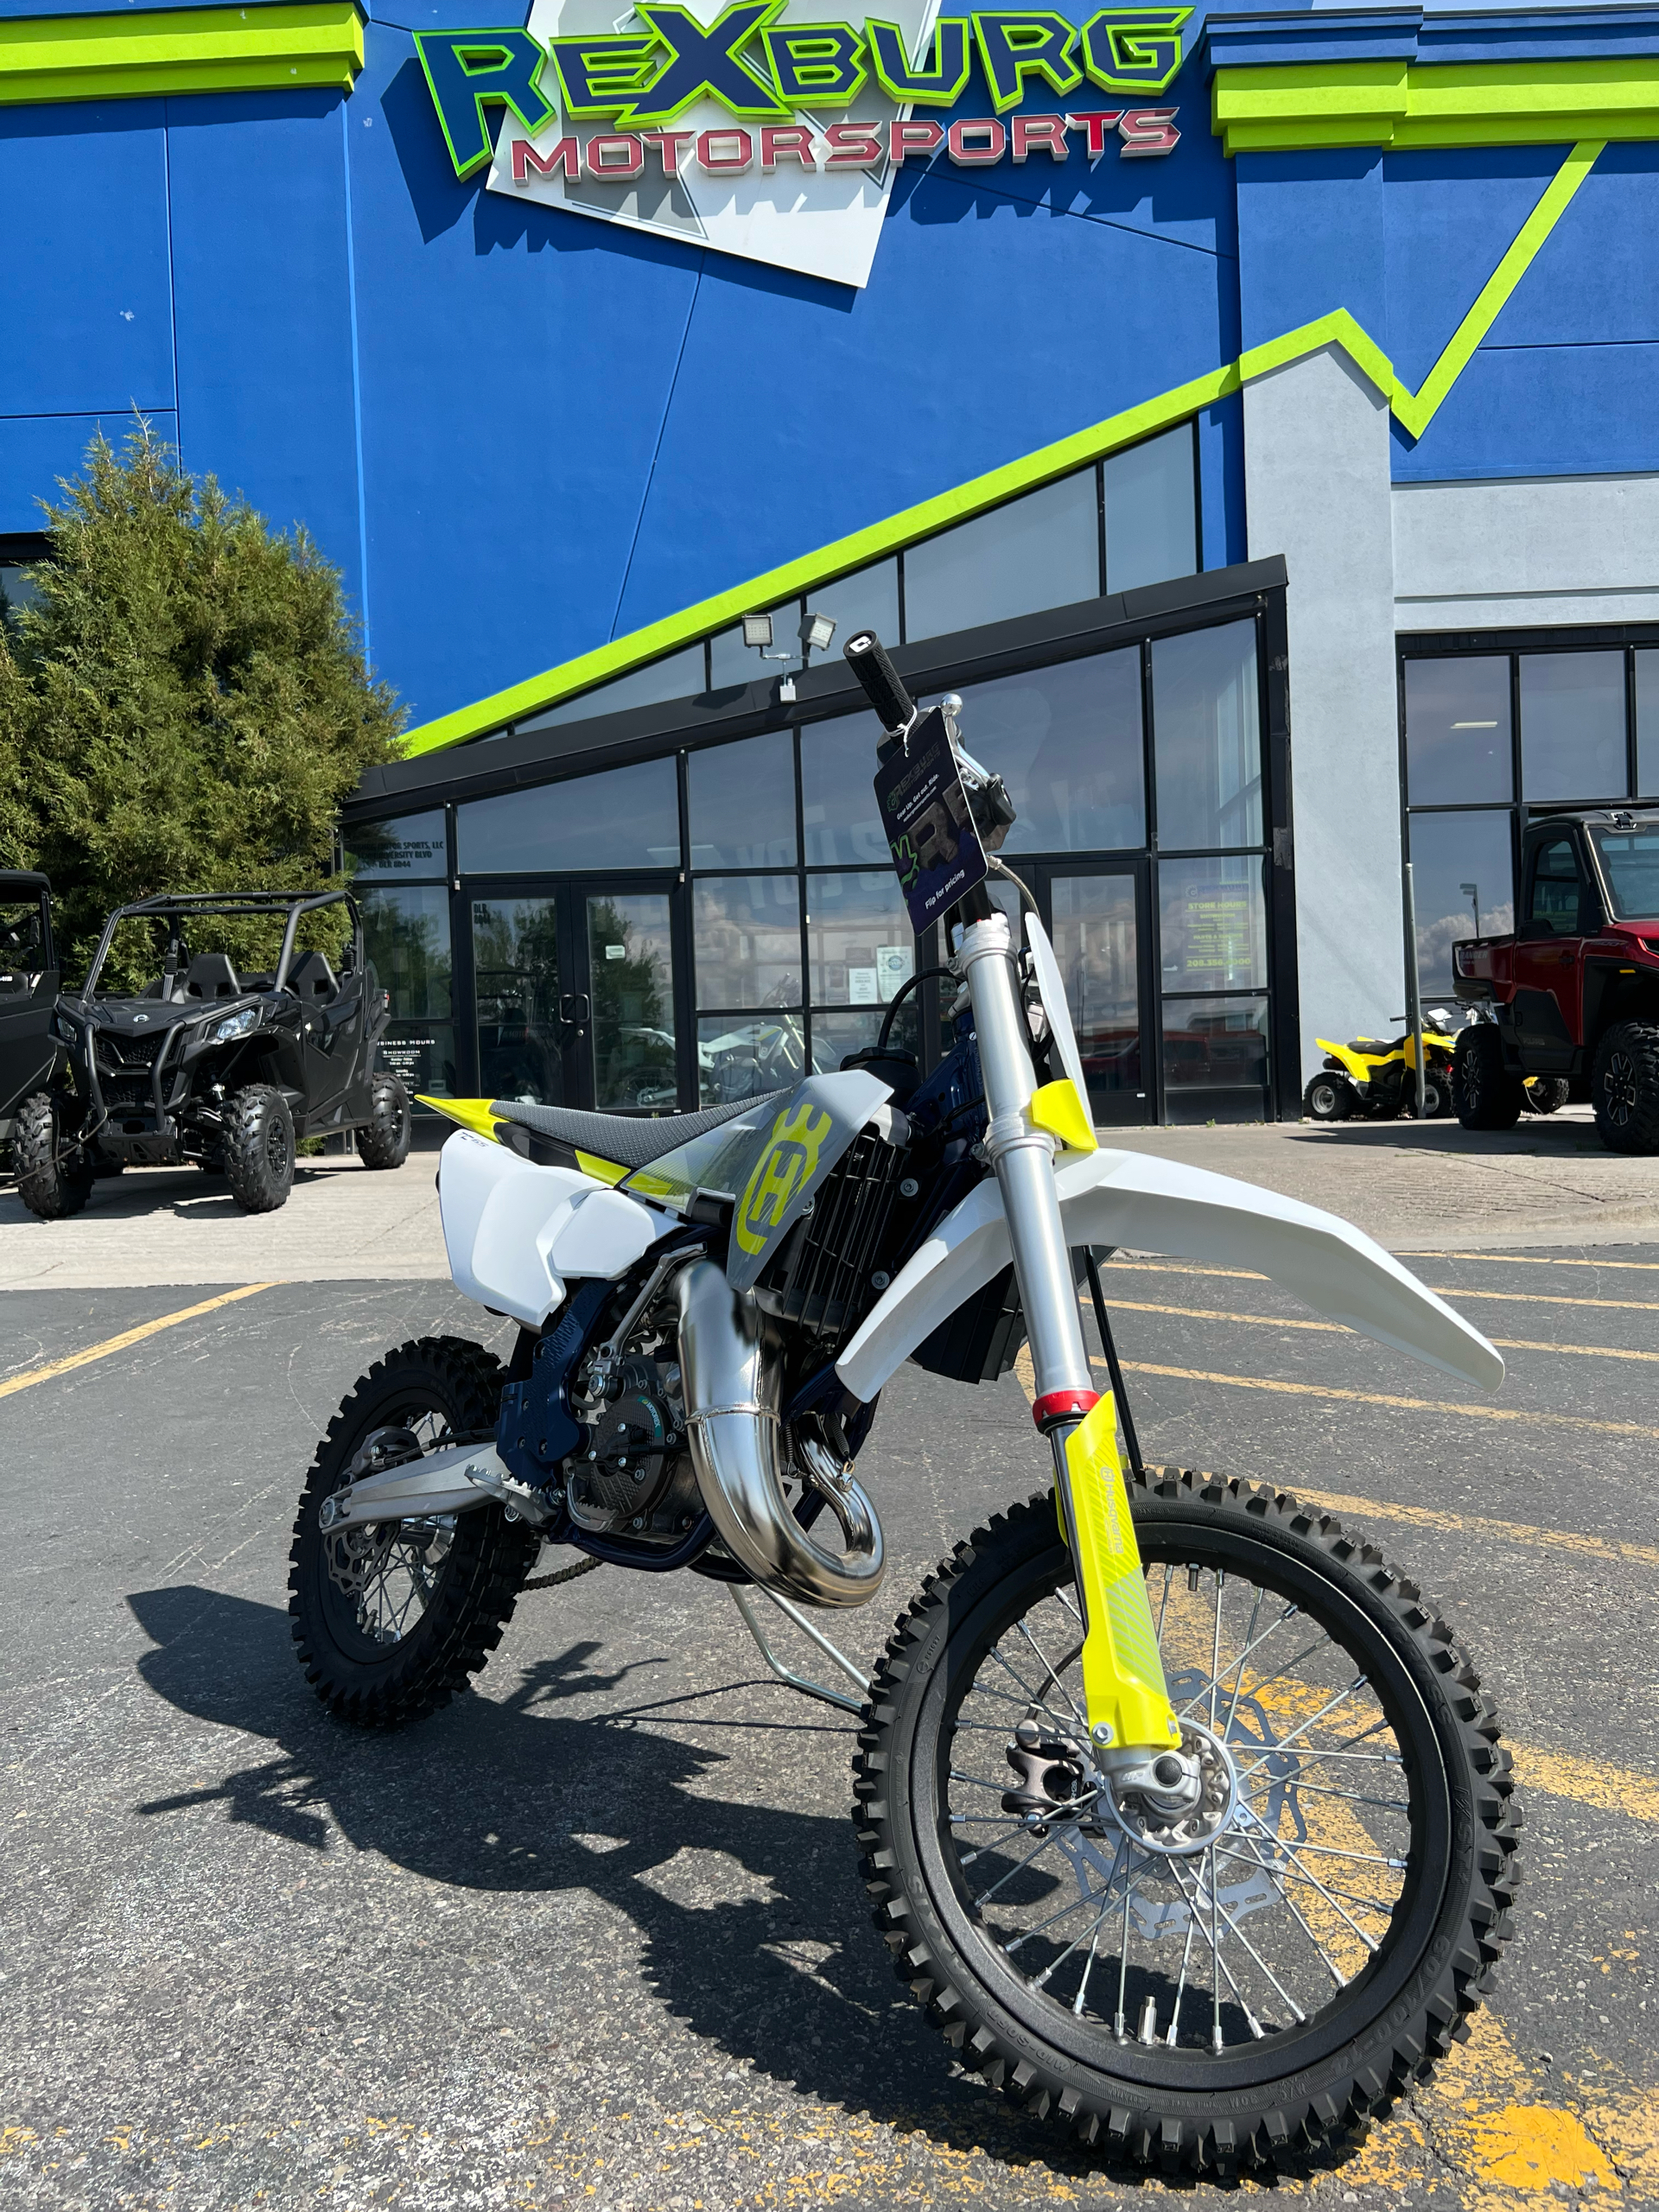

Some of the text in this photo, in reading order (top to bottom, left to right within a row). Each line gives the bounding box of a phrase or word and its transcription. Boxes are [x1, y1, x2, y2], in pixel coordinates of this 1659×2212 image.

[412, 0, 1195, 181] REXBURG
[512, 106, 1181, 186] MOTORSPORTS
[897, 808, 907, 820] Gear
[403, 841, 431, 850] SPORTS,
[432, 841, 445, 849] LLC
[474, 903, 487, 913] DLR
[925, 868, 966, 910] Flip for pricing
[1459, 950, 1489, 959] RANGER
[645, 1402, 661, 1428] MOTOREX
[1104, 1483, 1124, 1554] Husqvarna
[907, 1875, 988, 2000] MAXXIS
[1330, 1934, 1451, 2075] 60/100-14
[987, 2007, 1070, 2073] MID-SOFT
